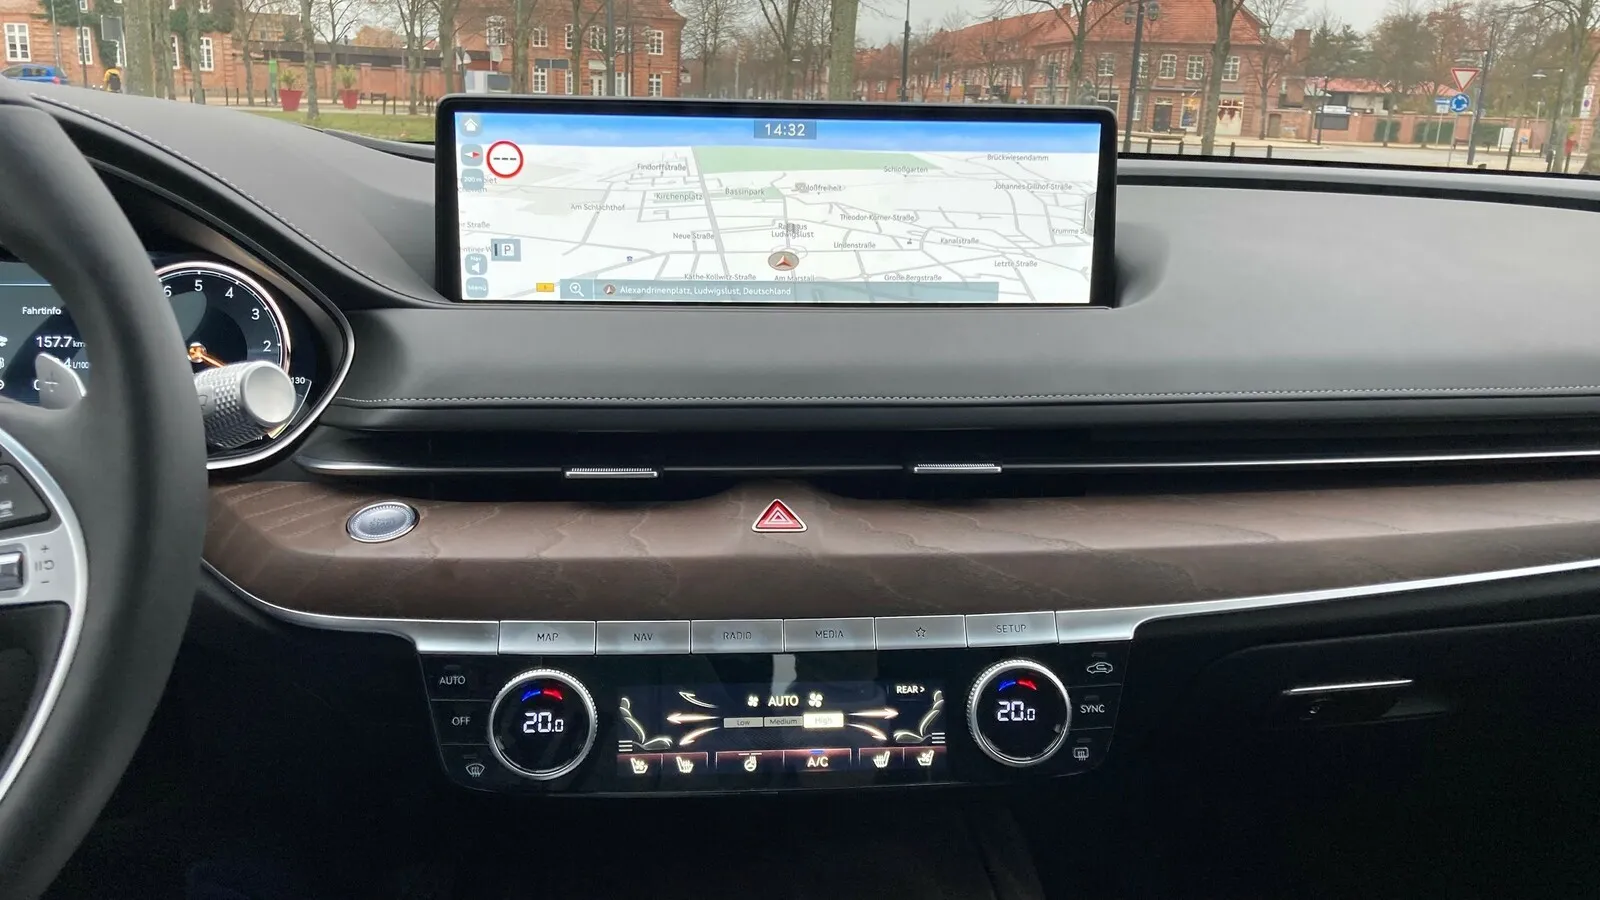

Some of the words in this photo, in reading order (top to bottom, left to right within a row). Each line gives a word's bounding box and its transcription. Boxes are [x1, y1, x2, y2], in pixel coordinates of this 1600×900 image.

[765, 123, 805, 136] 14:32
[656, 192, 703, 201] Kirchenplatz
[725, 187, 765, 196] Bassinpark
[584, 203, 625, 211] Schlachthof
[692, 232, 715, 240] Straße
[941, 237, 980, 245] Kanalstraße
[504, 245, 511, 254] P
[906, 274, 942, 282] Bergstraße
[694, 287, 741, 297] Ludwigslust,
[743, 287, 791, 296] Deutschland
[22, 306, 62, 315] Fahrtinfo
[36, 335, 73, 348] 157.7
[815, 629, 844, 639] MEDIA
[996, 624, 1027, 634] SETUP
[537, 632, 559, 642] MAP
[633, 632, 653, 642] NAV
[723, 631, 752, 640] RADIO
[439, 675, 466, 685] AUTO
[896, 686, 918, 694] REAR
[767, 695, 799, 707] AUTO
[998, 700, 1035, 722] 20.0
[1080, 704, 1105, 714] SYNC
[451, 716, 471, 726] OFF
[523, 711, 564, 734] 20.0
[769, 717, 798, 725] Medium
[807, 756, 829, 767] A/C
